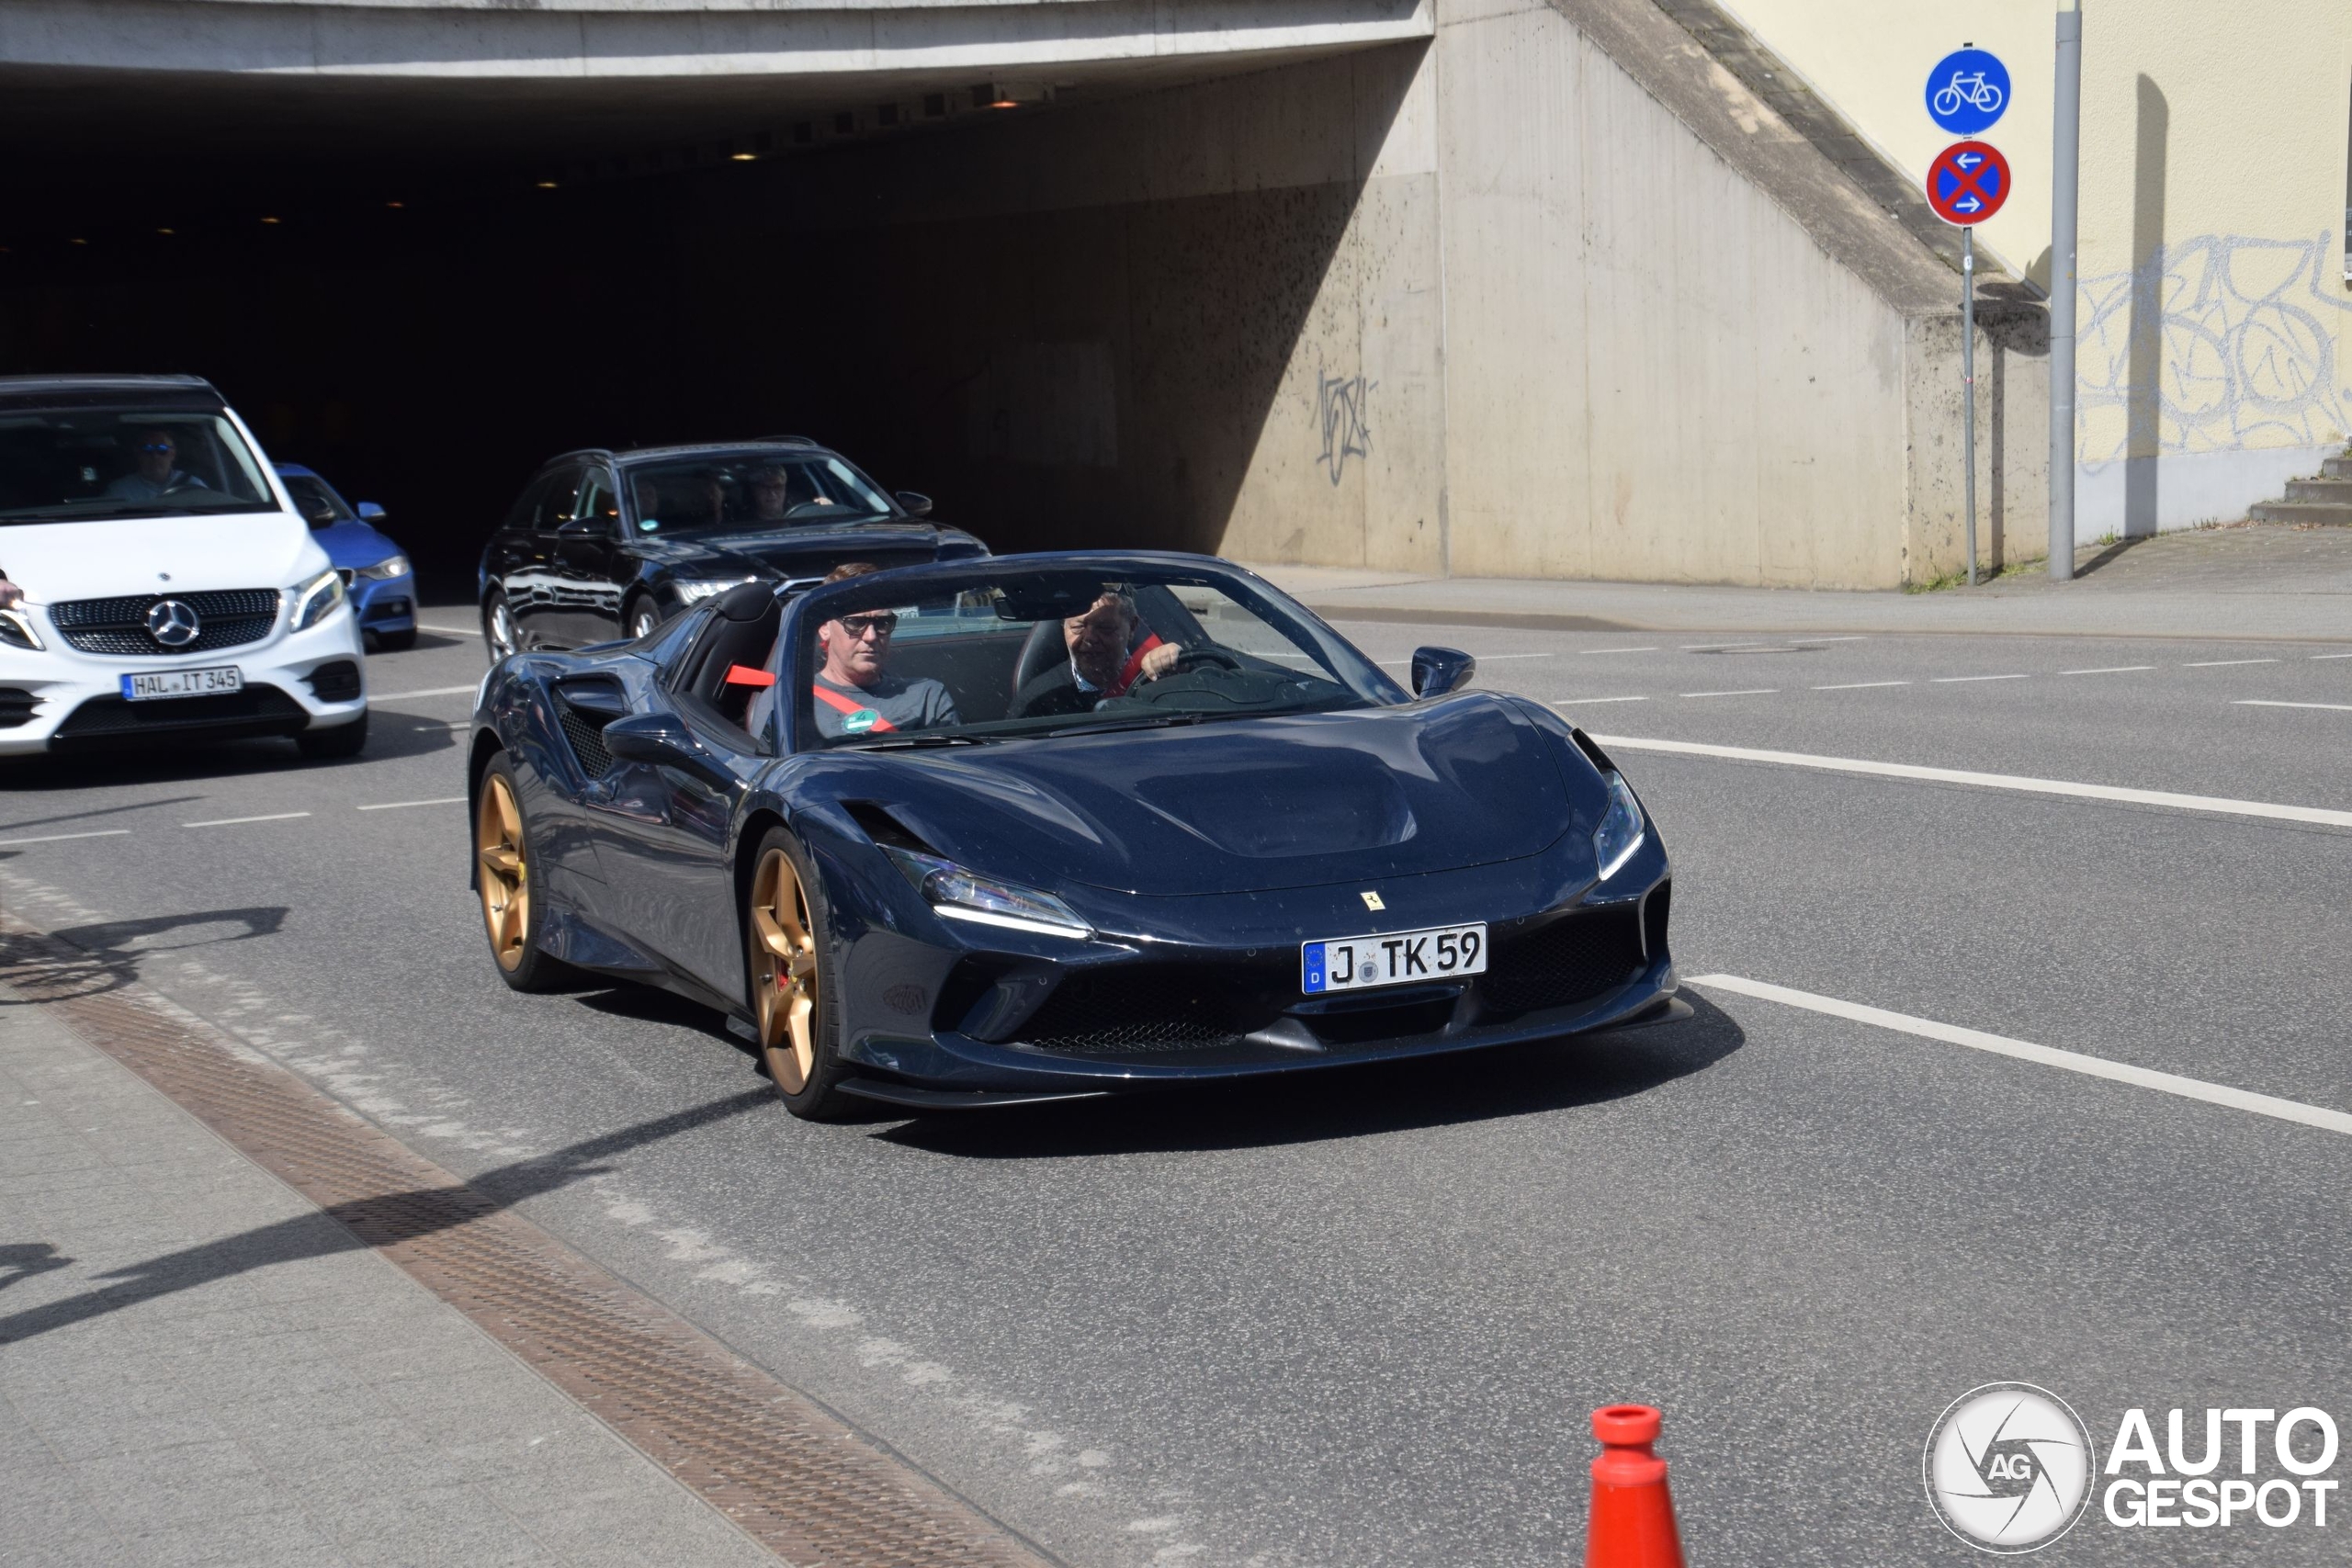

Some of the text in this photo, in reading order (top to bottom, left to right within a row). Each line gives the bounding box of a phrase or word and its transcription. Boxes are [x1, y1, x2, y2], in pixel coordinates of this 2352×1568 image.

[133, 676, 169, 695] HAL
[182, 672, 200, 691] IT
[205, 670, 236, 690] 345
[1331, 931, 1480, 984] J TK 59
[1311, 973, 1319, 984] D
